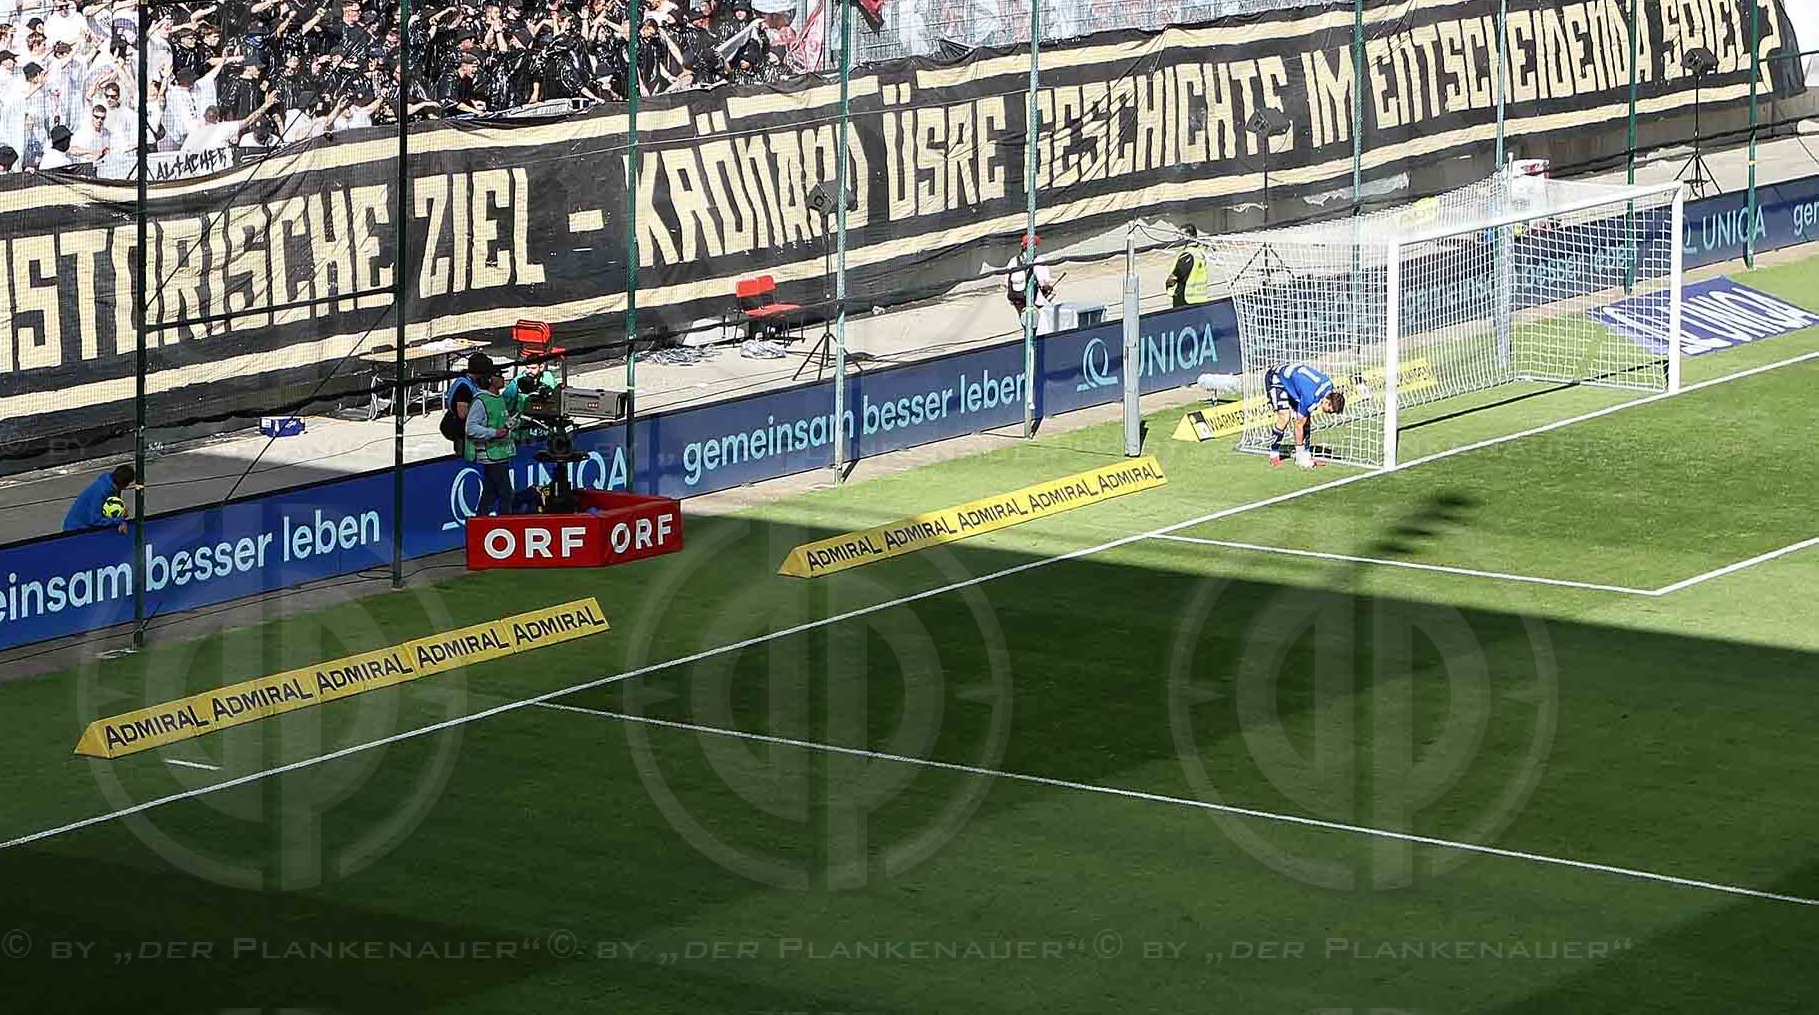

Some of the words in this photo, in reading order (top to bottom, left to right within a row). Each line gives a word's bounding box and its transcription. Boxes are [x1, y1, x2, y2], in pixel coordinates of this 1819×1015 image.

[415, 167, 546, 299] ZIEL
[883, 81, 1006, 222] ÜSRE
[1300, 44, 1355, 148] IM
[1702, 206, 1766, 250] UNIQA
[683, 407, 854, 486] gemeinsam
[862, 376, 950, 434] besser
[144, 528, 273, 593] besser
[283, 508, 381, 563] leben
[484, 525, 586, 560] ORF
[610, 513, 674, 555] ORF
[805, 533, 883, 571] ADMIRAL
[884, 517, 958, 552] ADMIRAL
[957, 499, 1030, 533] ADMIRAL
[1028, 477, 1098, 515] ADMIRAL
[1097, 463, 1164, 497] ADMIRAL
[104, 706, 209, 752] ADMIRAL
[211, 676, 314, 722] ADMIRAL
[315, 653, 414, 699] ADMIRAL
[416, 628, 511, 671] ADMIRAL
[512, 605, 605, 647] ADMIRAL
